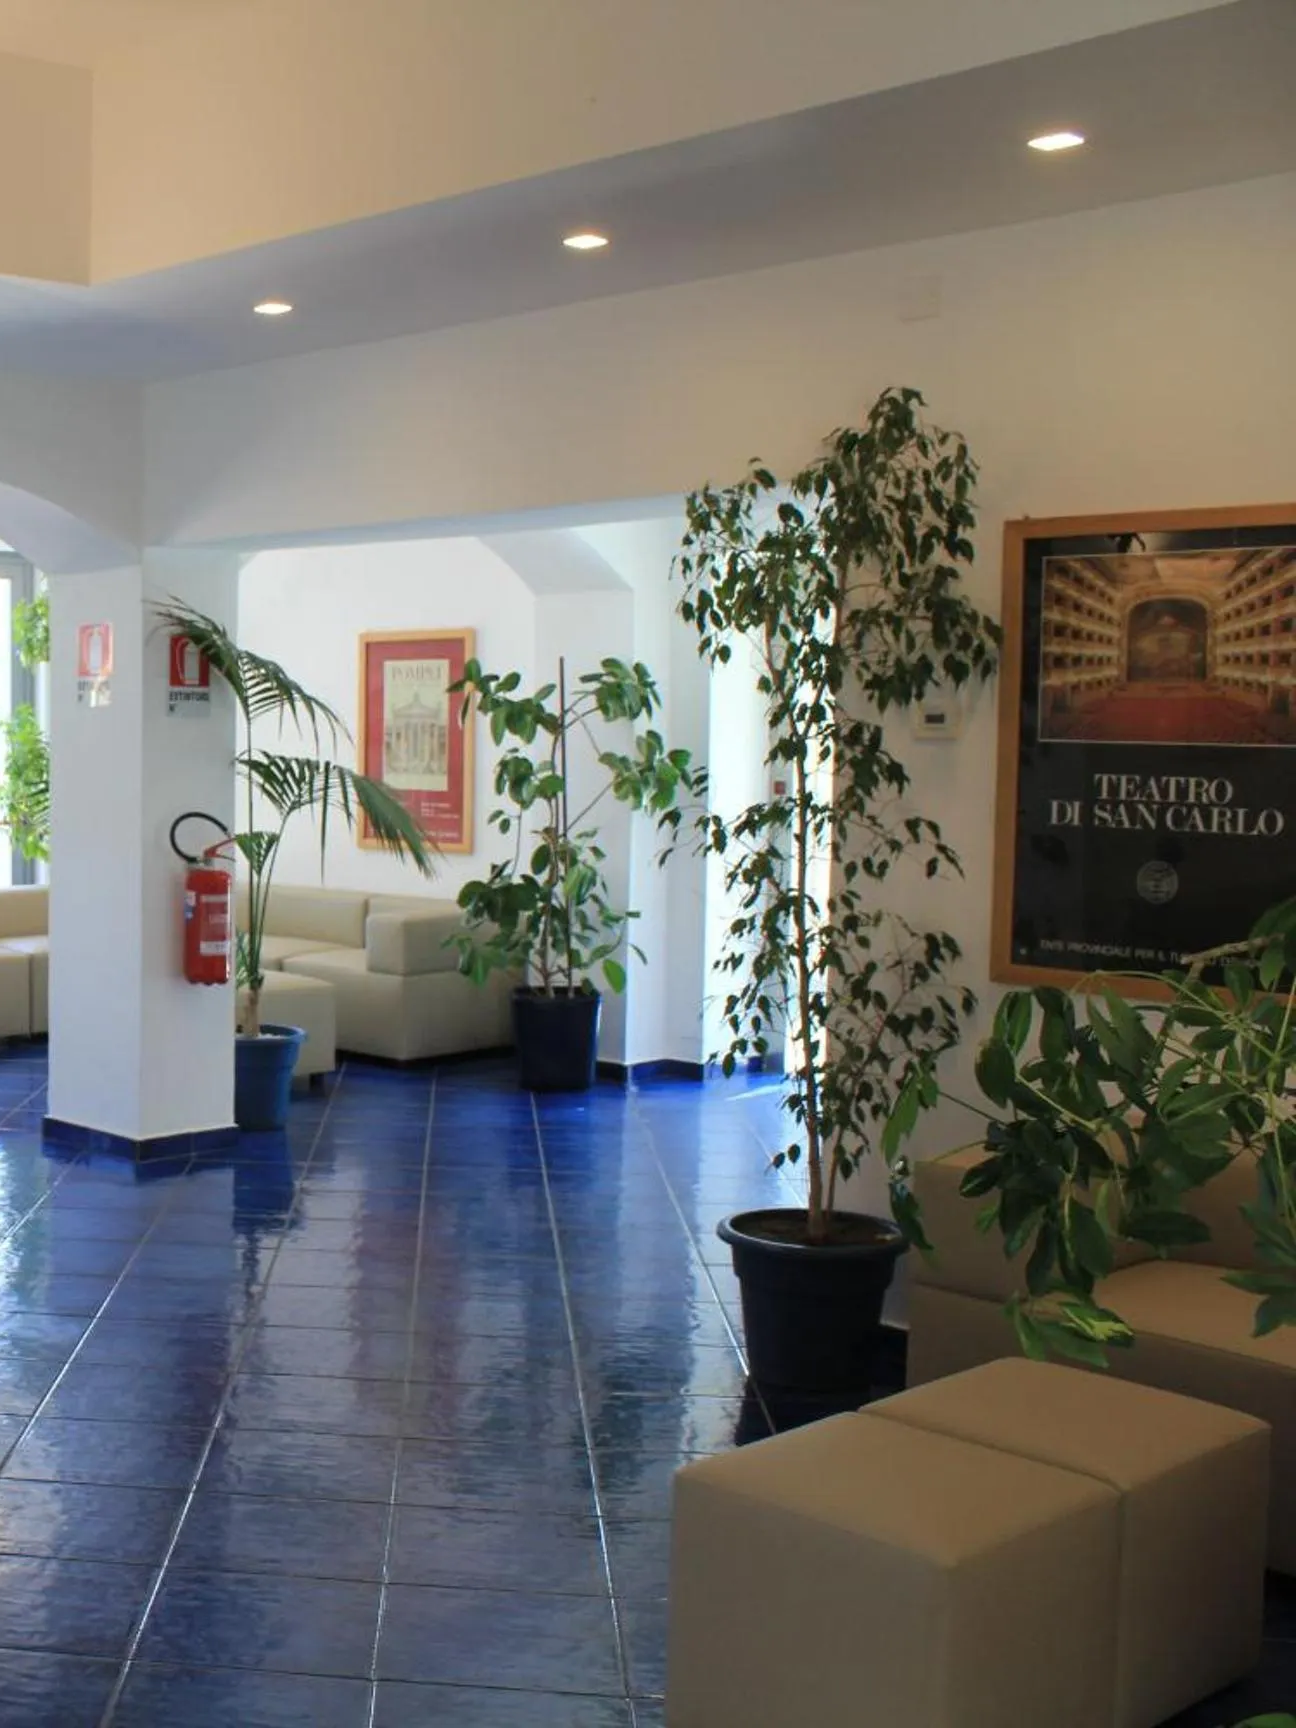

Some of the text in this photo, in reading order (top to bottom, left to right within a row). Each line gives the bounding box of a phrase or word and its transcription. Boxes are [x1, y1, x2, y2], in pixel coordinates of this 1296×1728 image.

[1093, 773, 1233, 805] TEATRO
[1050, 799, 1285, 836] DI SAN CARLO
[1040, 939, 1064, 952] ENTE
[1067, 942, 1131, 957] PROVINCIALE
[1134, 947, 1155, 959] PER
